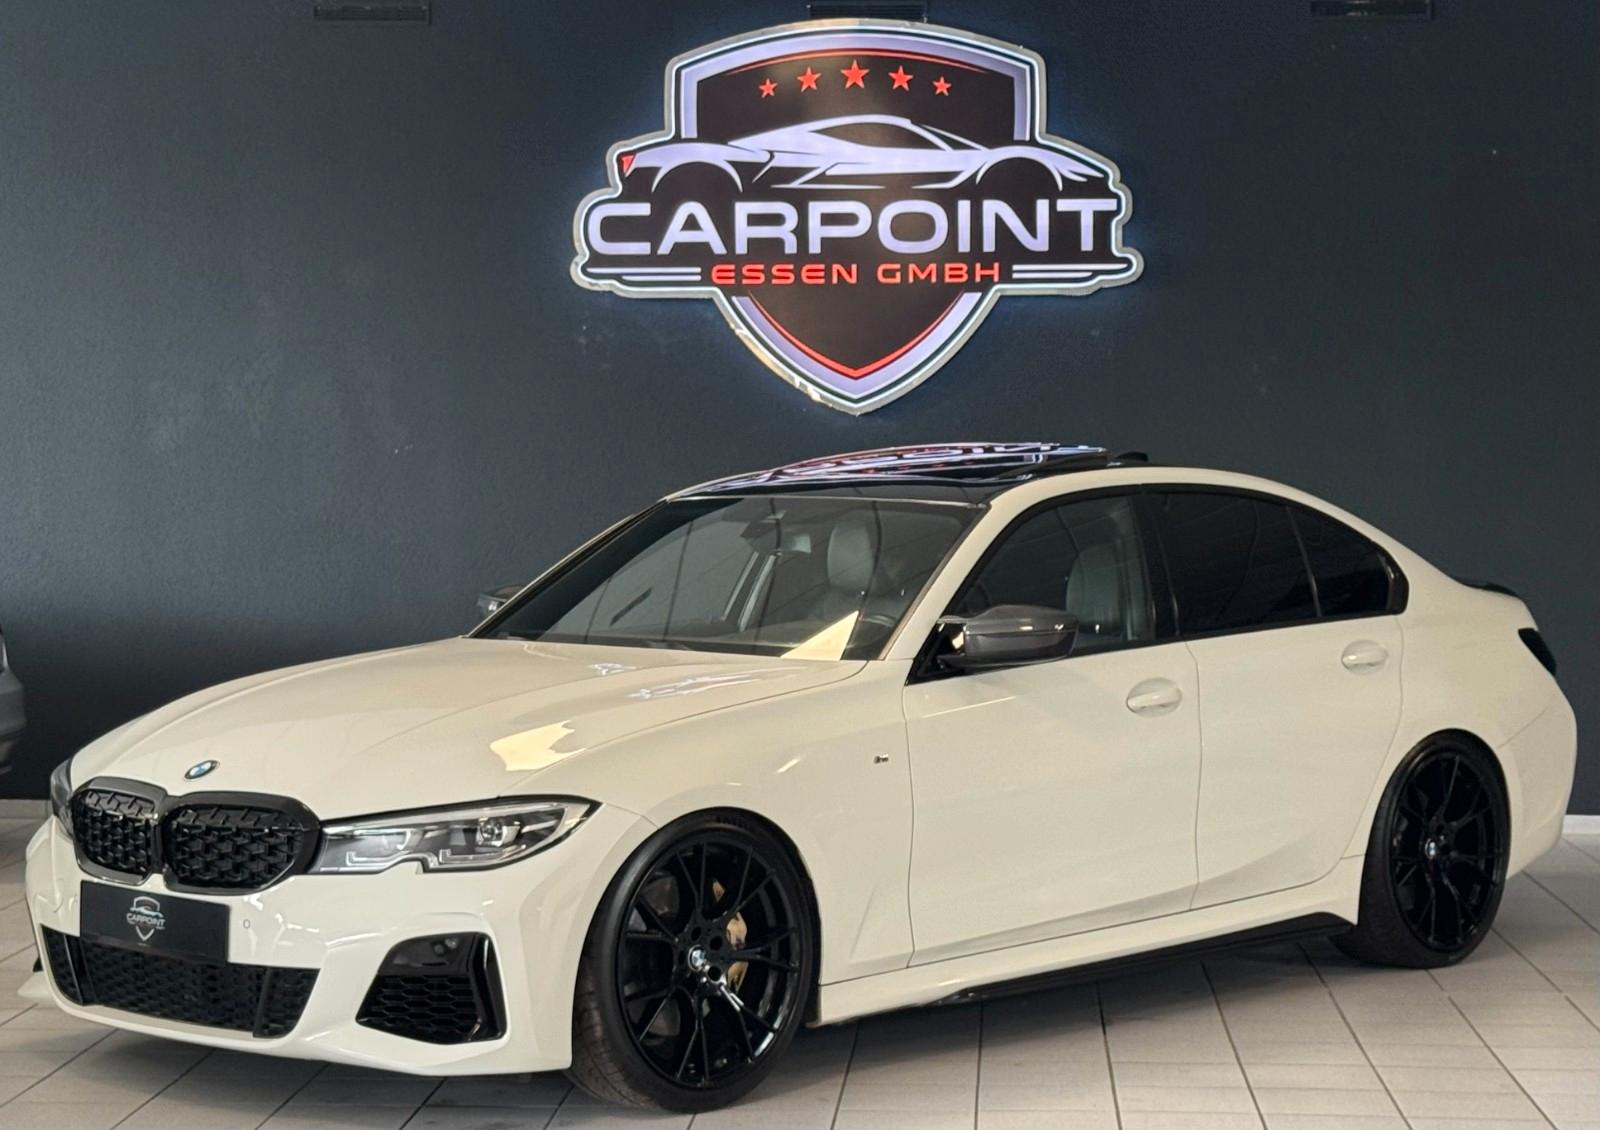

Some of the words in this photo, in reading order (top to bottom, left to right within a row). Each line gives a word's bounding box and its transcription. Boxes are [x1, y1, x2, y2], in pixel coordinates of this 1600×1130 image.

[588, 200, 1117, 255] CARPOINT
[711, 264, 857, 285] ESSEN
[877, 262, 1000, 284] GMBH
